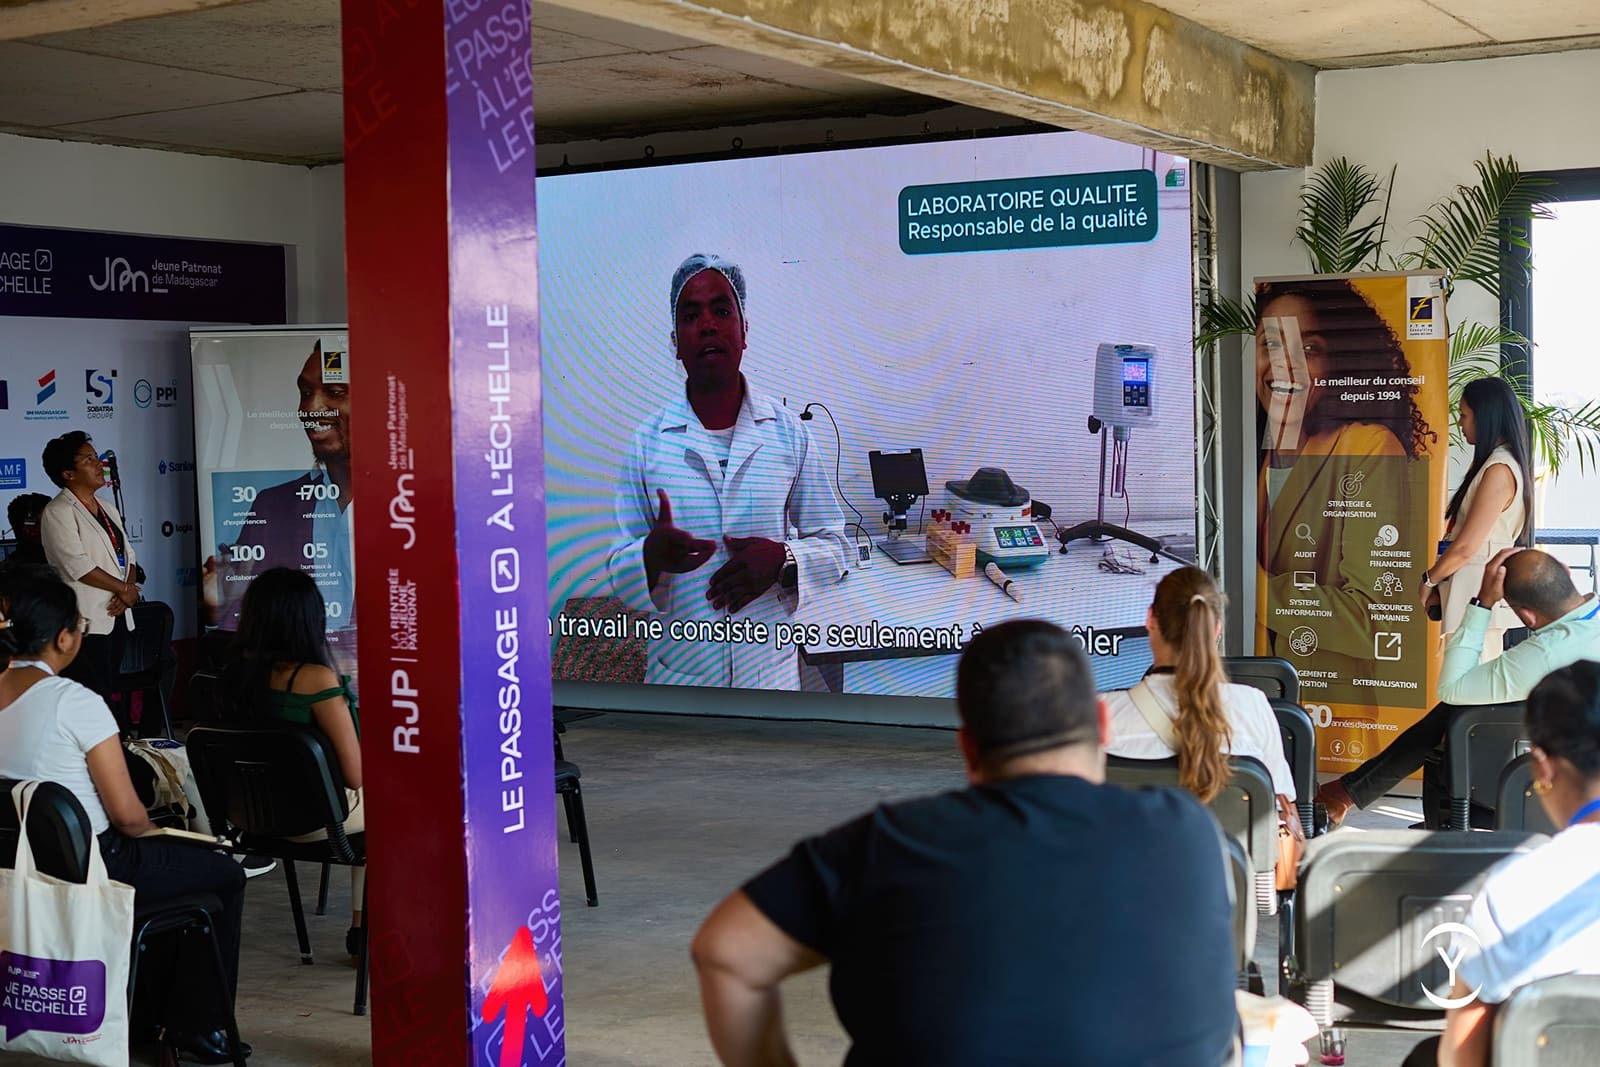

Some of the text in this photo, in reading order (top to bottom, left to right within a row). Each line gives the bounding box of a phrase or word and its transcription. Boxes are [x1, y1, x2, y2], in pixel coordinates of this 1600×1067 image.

[907, 183, 1138, 217] LABORATOIRE QUALITE
[907, 207, 1149, 241] Responsable de la qualité
[151, 259, 222, 274] Jeune Patronat
[151, 273, 218, 288] de Madagascar
[1314, 375, 1425, 387] Le meilleur du conseil
[1340, 390, 1401, 403] depuis 1994
[297, 409, 307, 418] du
[309, 408, 339, 418] conseil
[387, 375, 398, 470] Jeune Patronat
[398, 379, 409, 470] de Madagascar
[231, 486, 257, 503] 30
[295, 484, 340, 501] +700
[1327, 500, 1372, 508] STRATEGIE &
[1322, 510, 1377, 518] ORGANISATION
[229, 545, 266, 563] 100
[302, 543, 329, 560] 05
[1294, 551, 1317, 559] AUDIT
[1370, 550, 1411, 558] INGENIERIE
[484, 303, 526, 834] LE PASSAGE À L'ÉCHELLE
[1369, 560, 1412, 569] FINANCIERE
[387, 568, 400, 650] LA RENTRÉE
[1289, 599, 1320, 607] SYSTEME
[1367, 603, 1413, 612] RESSOURCES
[398, 584, 409, 650] DU JEUNE
[407, 579, 418, 650] PATRONAT
[1275, 608, 1333, 617] D'INFORMATION
[1370, 613, 1410, 622] HUMAINES
[559, 614, 628, 638] travail
[635, 620, 663, 639] ne
[670, 617, 768, 643] consiste
[776, 623, 820, 649] pas
[827, 620, 963, 650] seulement
[1327, 671, 1338, 679] DE
[1352, 678, 1418, 689] EXTERNALISATION
[391, 669, 420, 754] RJP
[5, 981, 67, 1001] JE PASSE
[15, 998, 88, 1016] L'ECHELLE
